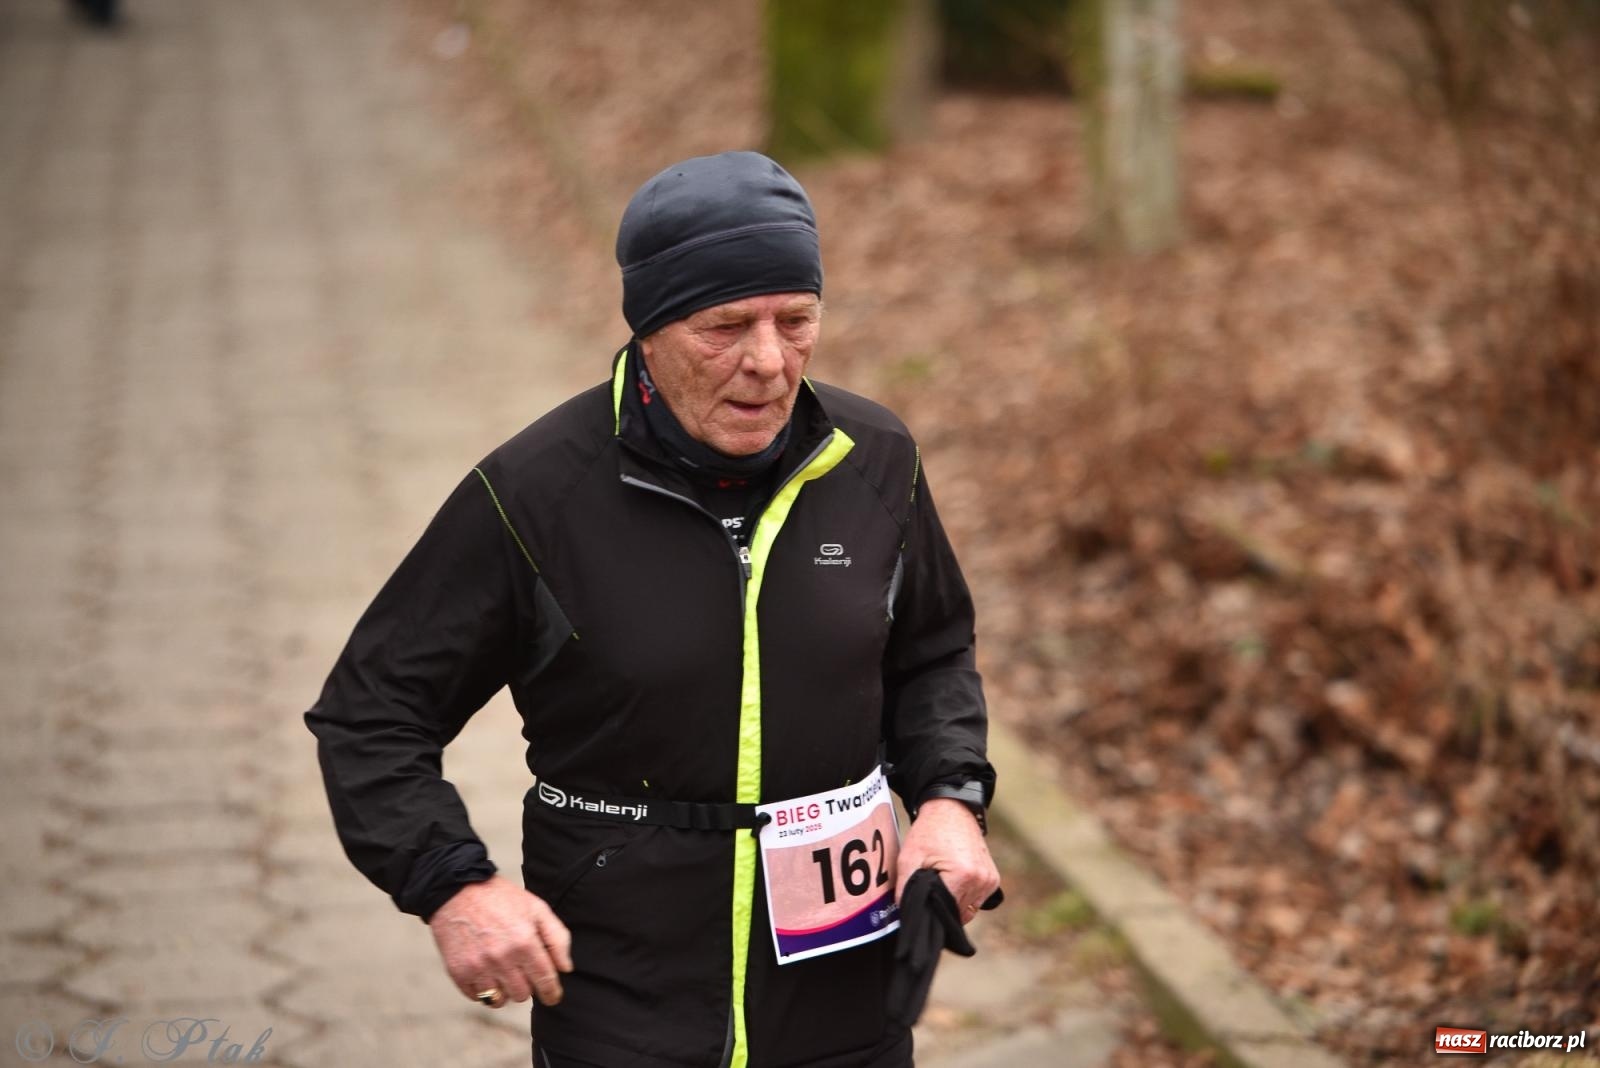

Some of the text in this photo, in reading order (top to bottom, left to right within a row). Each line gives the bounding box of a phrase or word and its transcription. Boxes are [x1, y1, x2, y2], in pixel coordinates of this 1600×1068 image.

[814, 556, 852, 567] Kalenji
[570, 795, 648, 821] Kalenji
[776, 804, 820, 827] BIEG
[812, 829, 888, 905] 162
